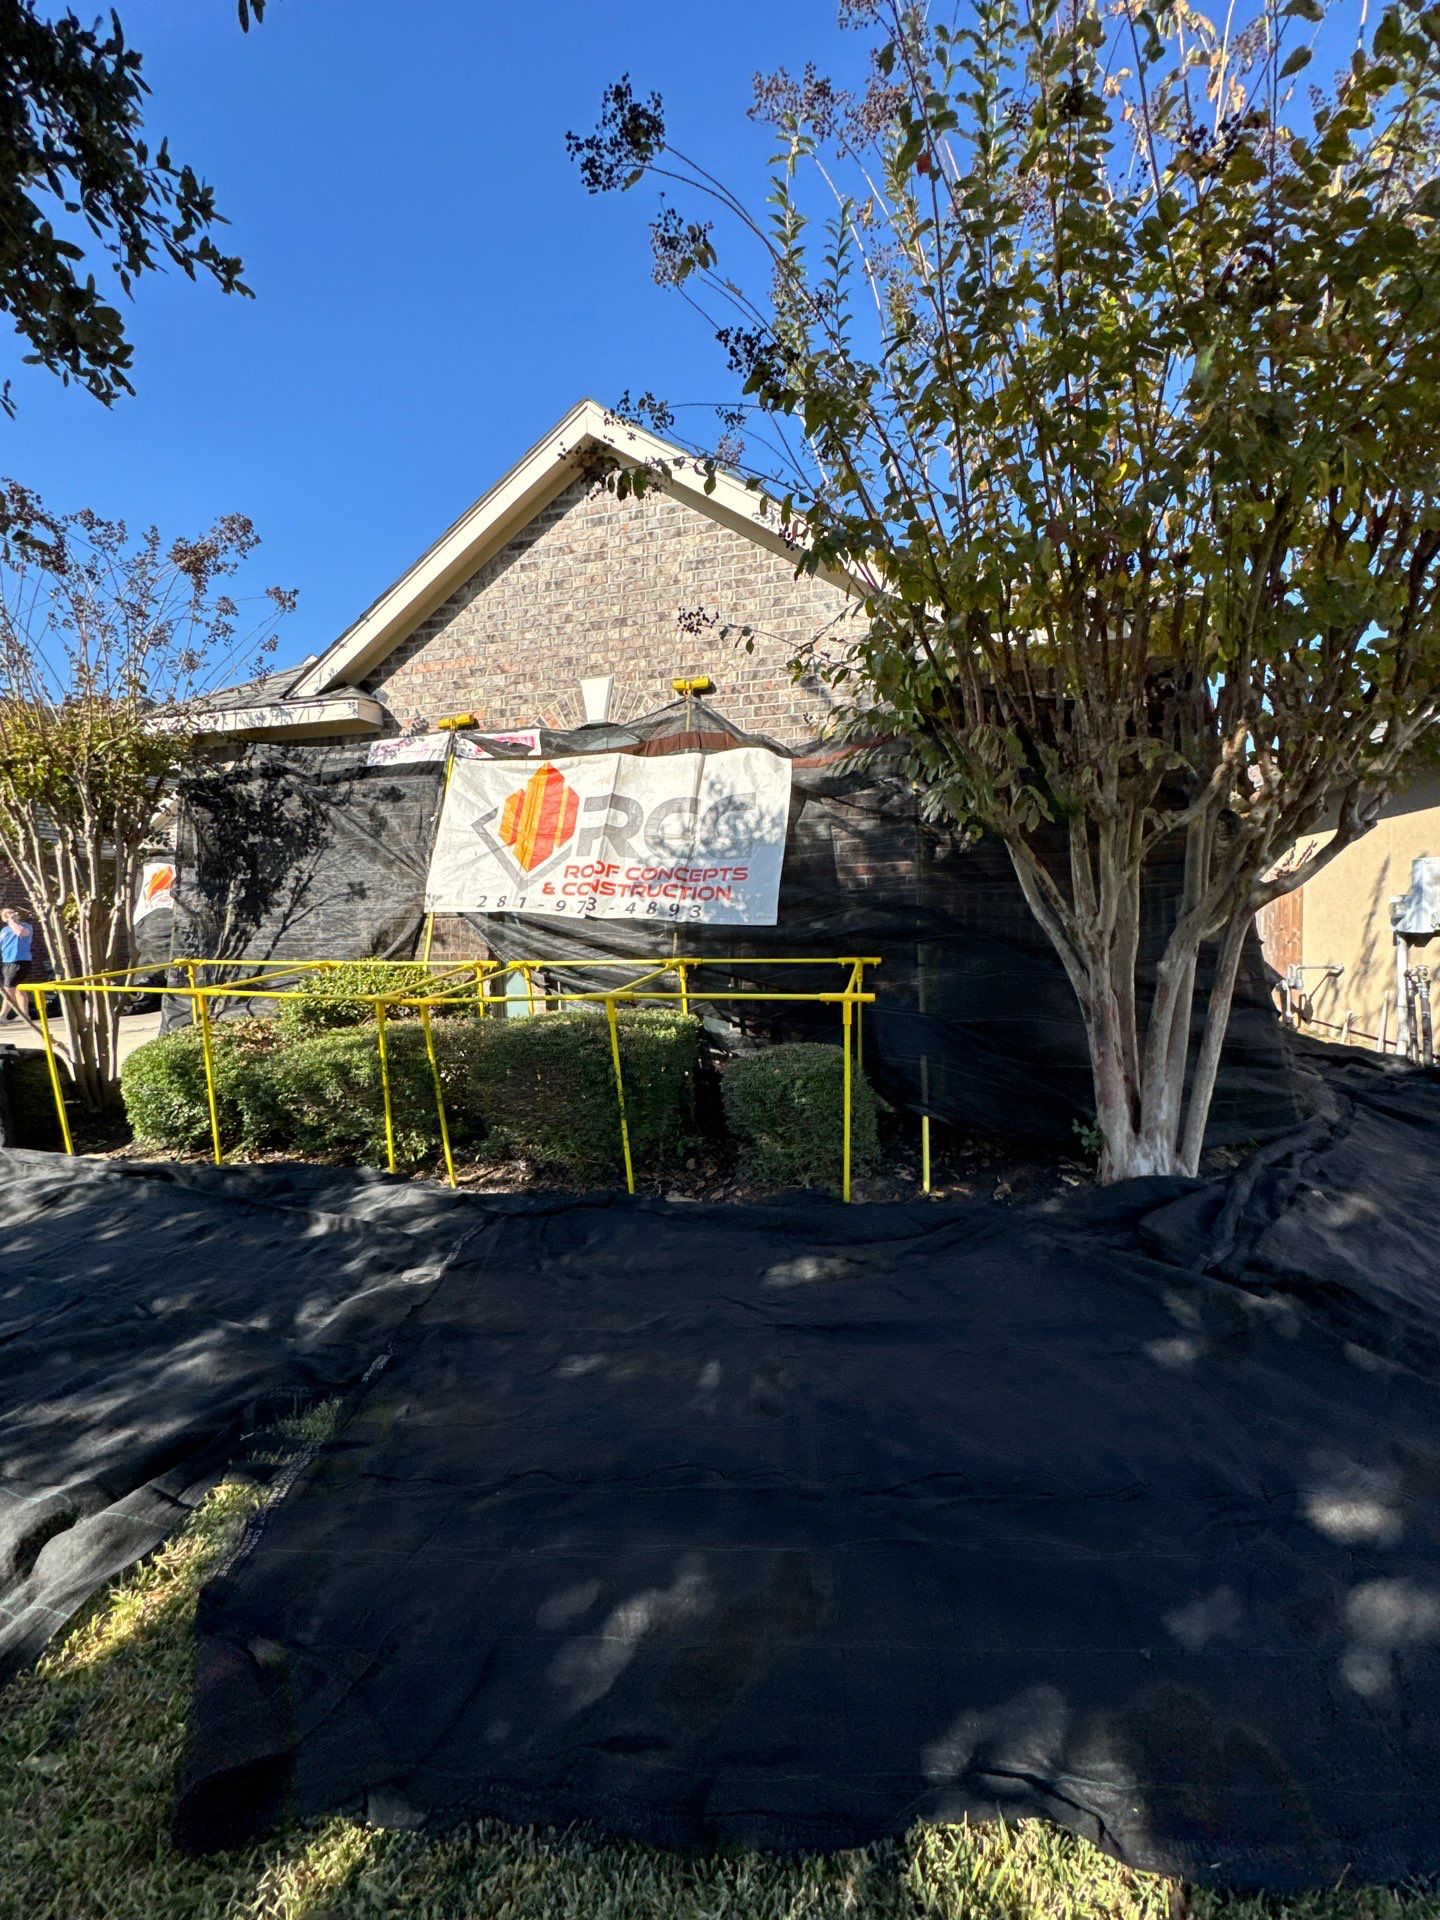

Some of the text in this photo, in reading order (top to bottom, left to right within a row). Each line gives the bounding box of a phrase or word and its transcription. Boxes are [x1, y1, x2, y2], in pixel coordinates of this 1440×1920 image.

[563, 860, 749, 883] ROOF CONCEPTS
[542, 879, 732, 901] & CONSTRUCTION
